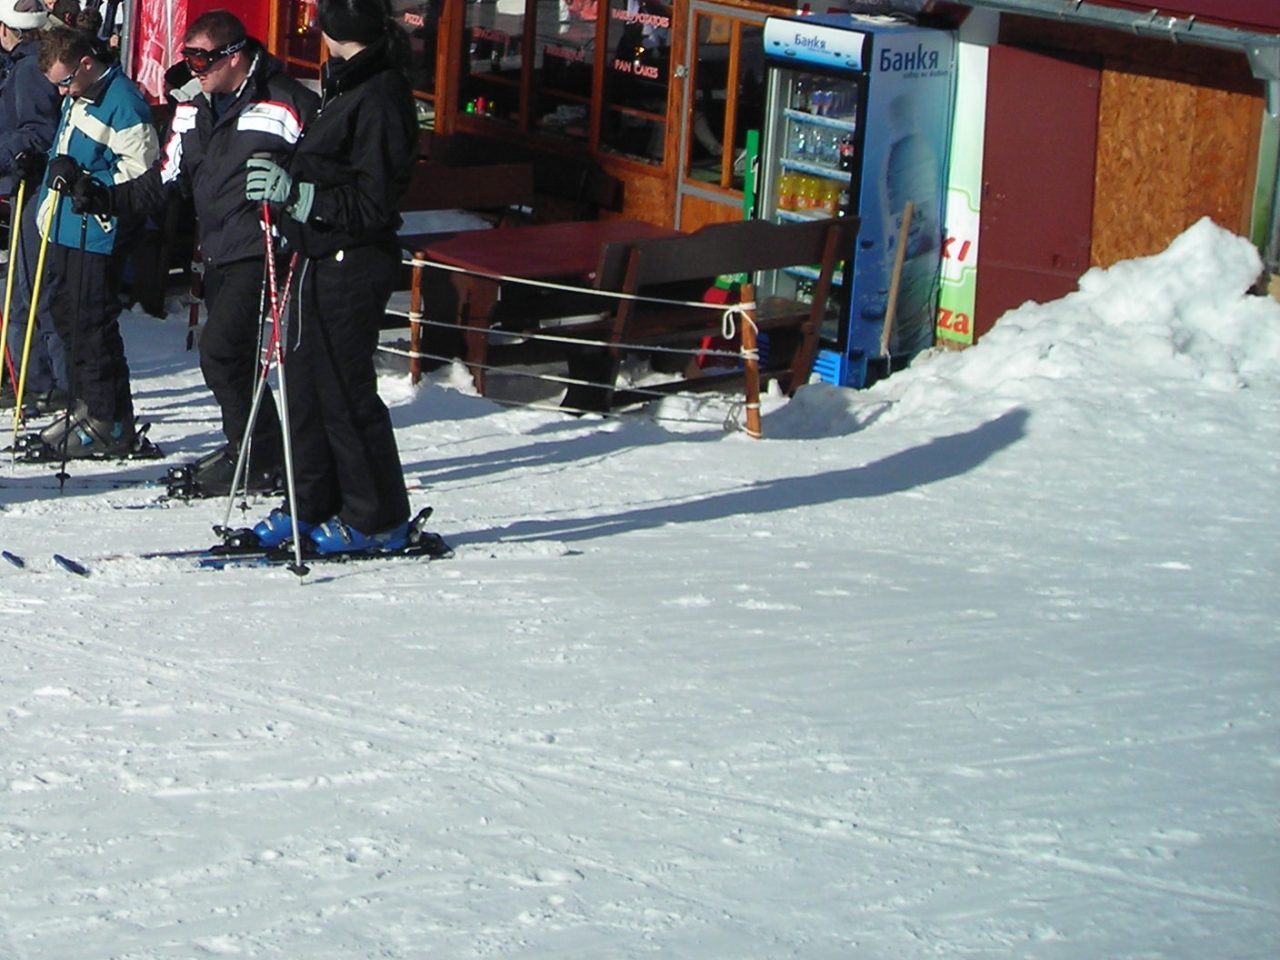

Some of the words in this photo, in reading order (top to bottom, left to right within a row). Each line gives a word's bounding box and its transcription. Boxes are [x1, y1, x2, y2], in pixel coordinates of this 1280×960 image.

[404, 12, 424, 27] PIZZA
[794, 33, 826, 49] Банкя
[879, 43, 939, 72] Банкя
